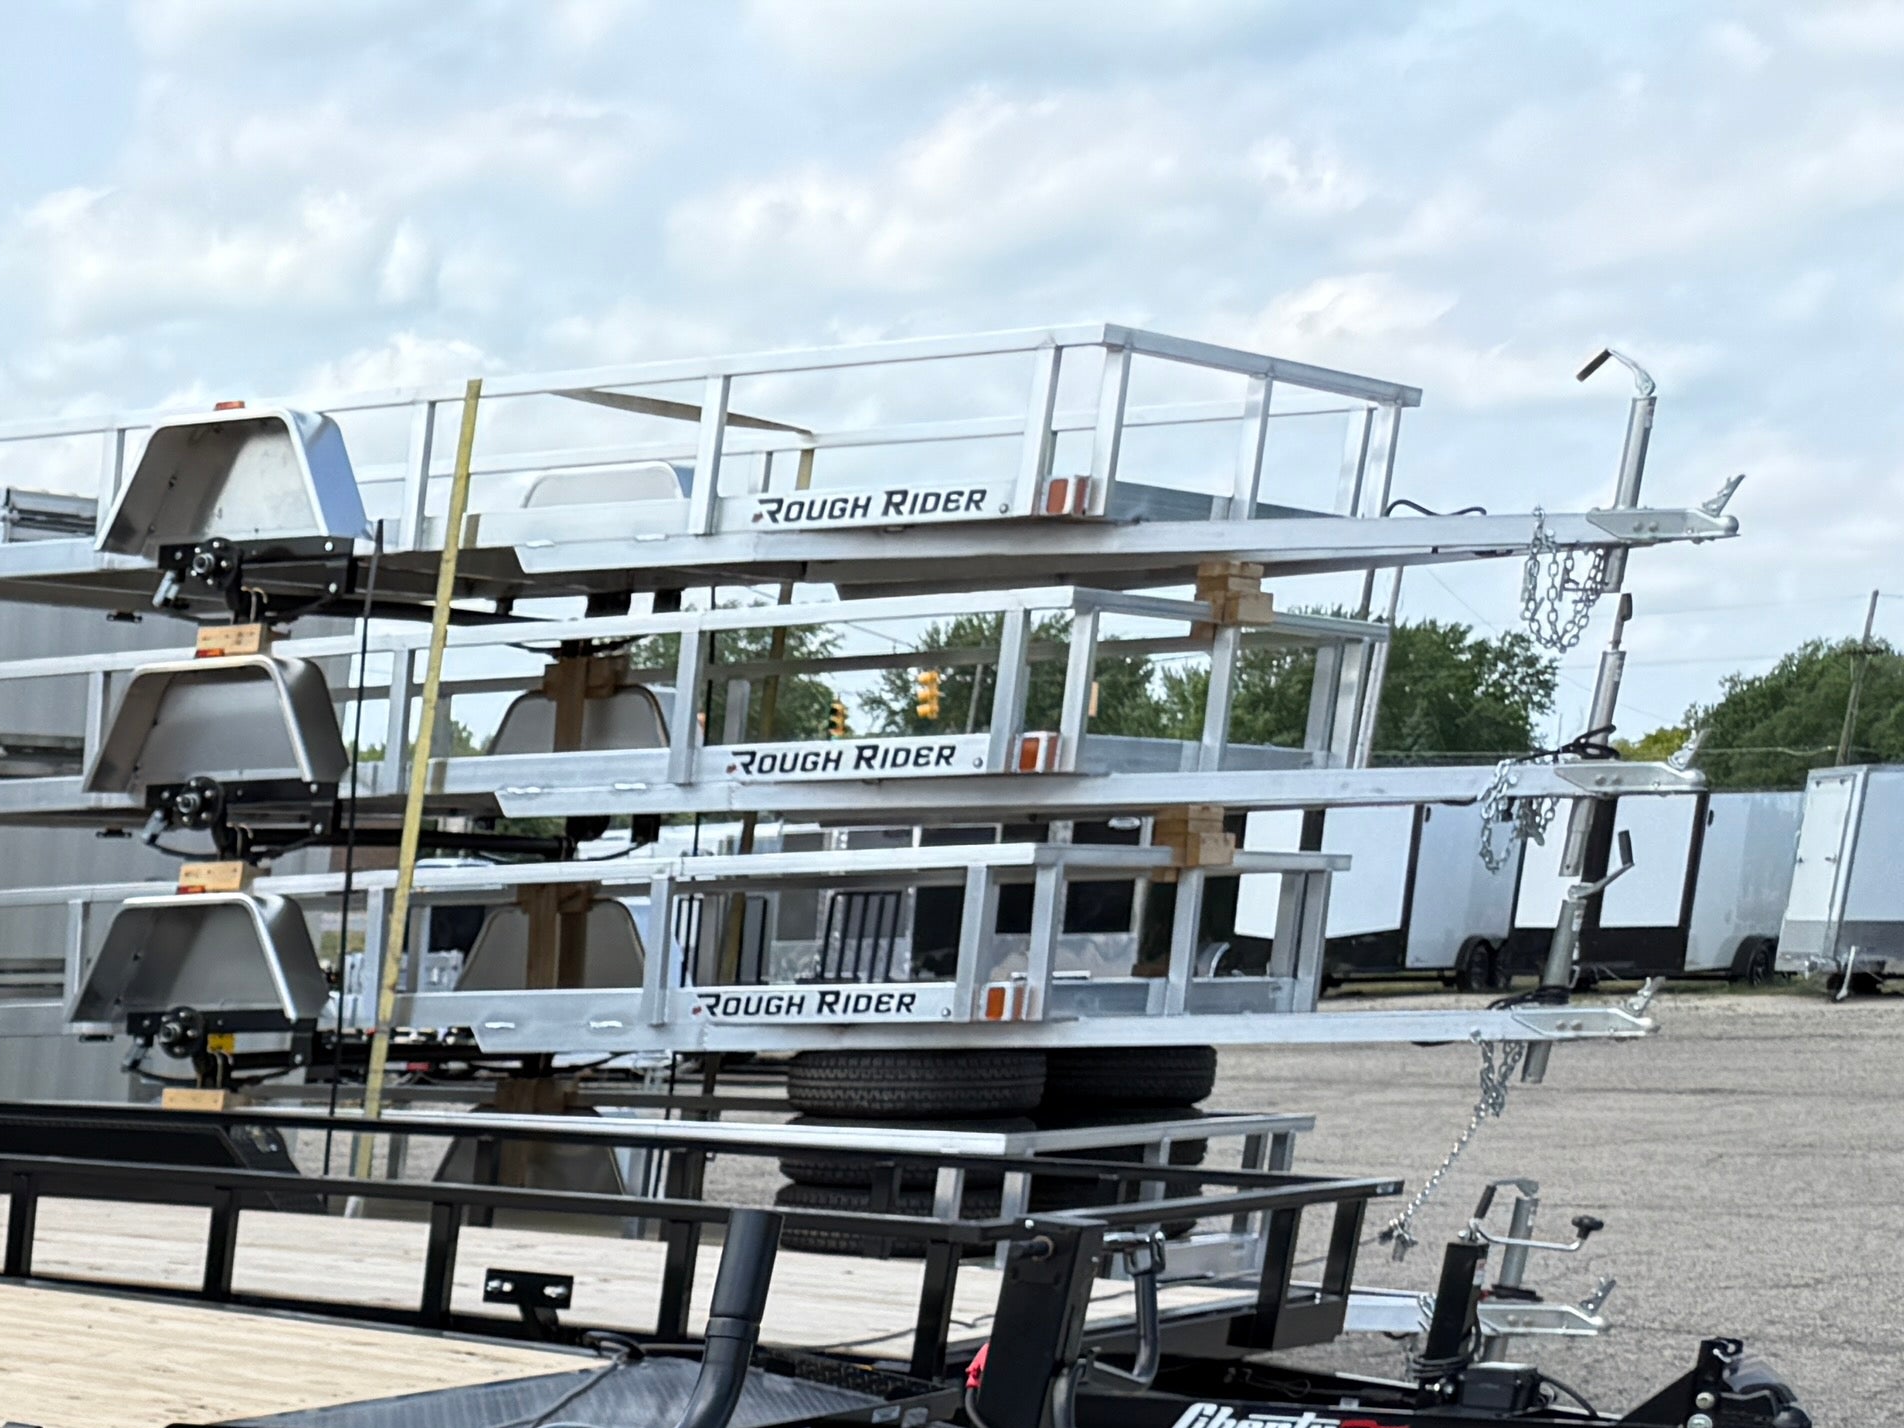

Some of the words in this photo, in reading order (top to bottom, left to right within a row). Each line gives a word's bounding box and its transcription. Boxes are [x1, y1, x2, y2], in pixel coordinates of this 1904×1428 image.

[753, 496, 872, 524] ROUGH
[881, 489, 987, 516] RIDER
[727, 750, 843, 775] ROUGH
[853, 745, 956, 770] RIDER
[692, 993, 805, 1016] ROUGH
[817, 990, 917, 1014] RIDER
